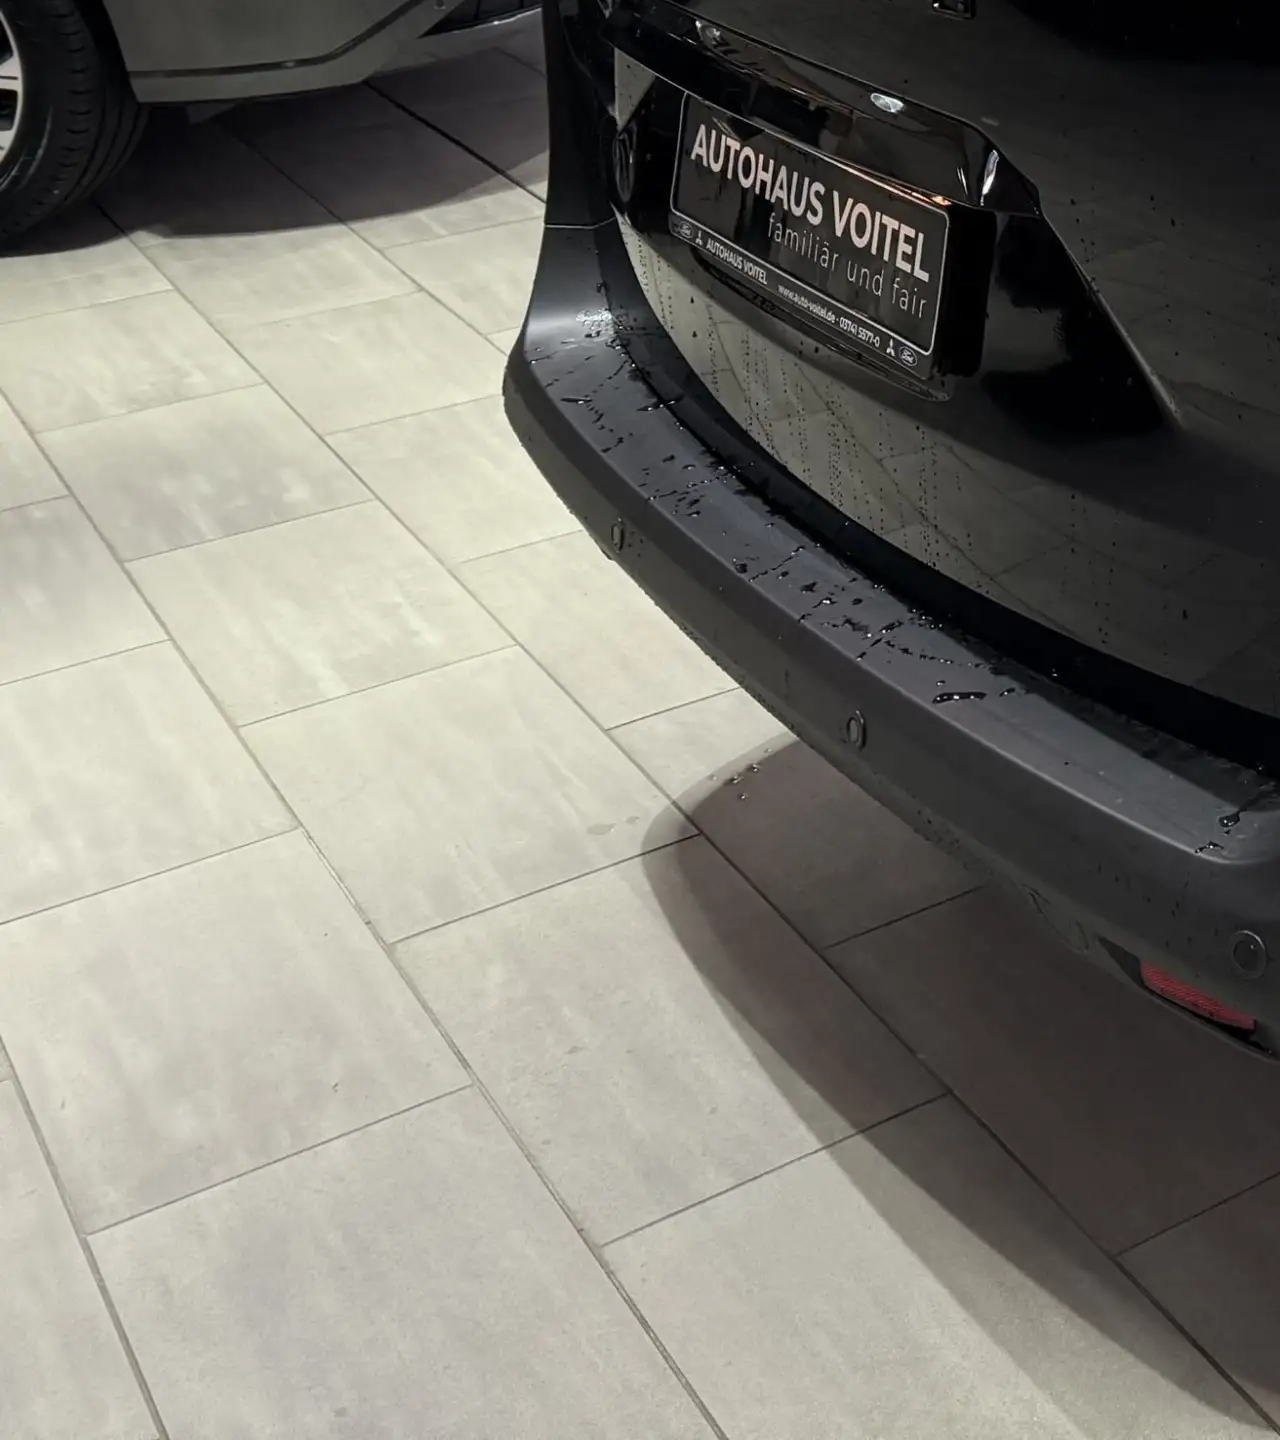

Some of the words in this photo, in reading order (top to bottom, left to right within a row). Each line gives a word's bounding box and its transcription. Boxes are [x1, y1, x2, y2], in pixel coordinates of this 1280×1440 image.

[690, 124, 826, 226] AUTOHAUS
[832, 190, 930, 282] VOITEL
[706, 238, 744, 269] AUTOHAUS
[743, 258, 768, 285] VOITEL
[768, 212, 839, 271] familiär
[847, 258, 885, 297] und
[892, 275, 927, 319] fair
